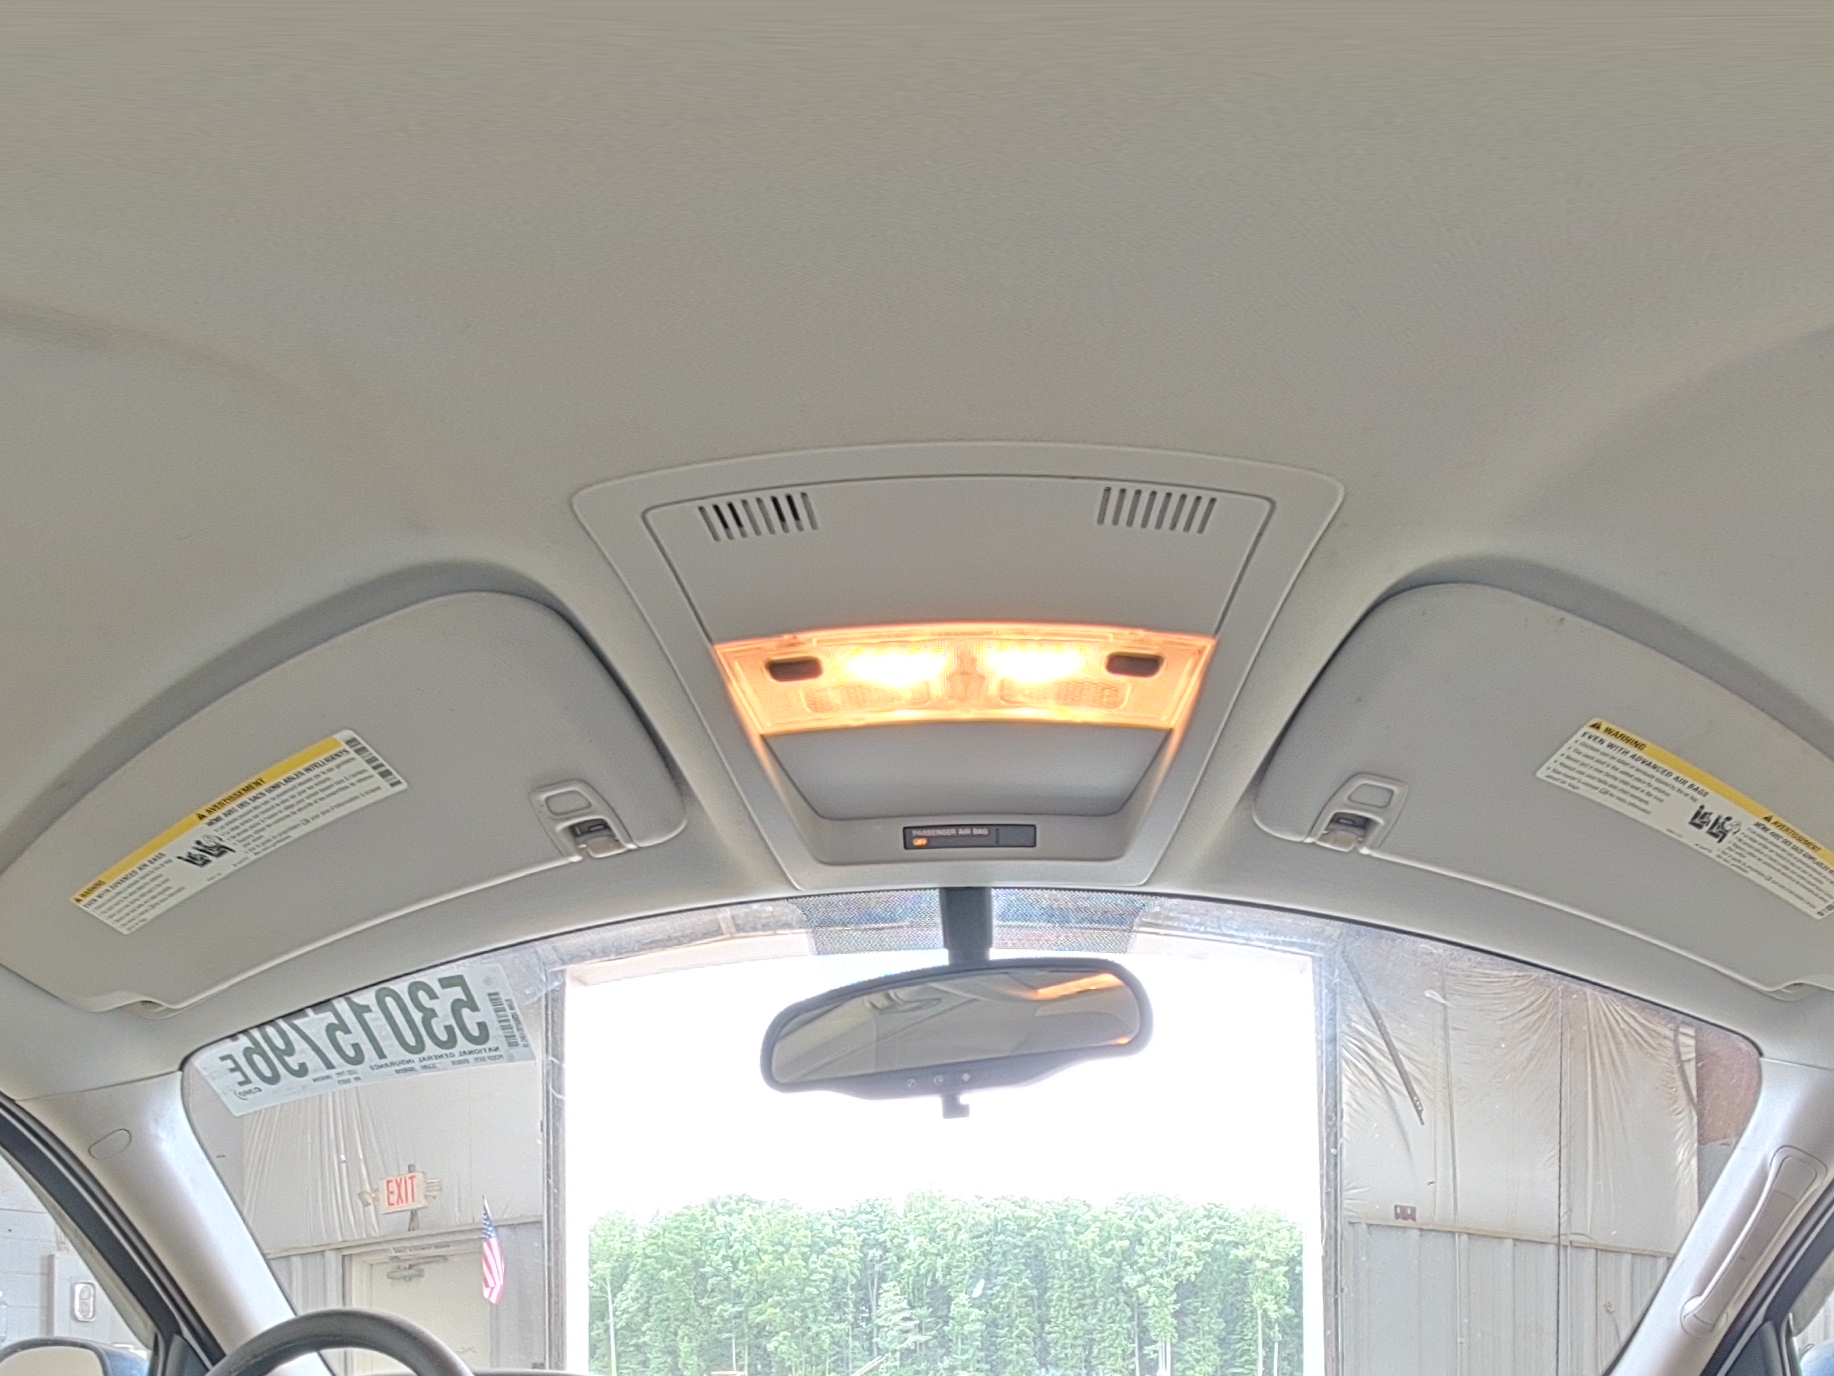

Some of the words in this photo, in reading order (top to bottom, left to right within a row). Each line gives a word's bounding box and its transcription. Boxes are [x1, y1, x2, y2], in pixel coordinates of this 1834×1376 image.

[1602, 726, 1648, 752] WARNING
[1581, 731, 1606, 746] EVEN
[1606, 741, 1631, 757] WITH
[1629, 753, 1674, 778] ADVANCED
[1673, 774, 1689, 787] AIR
[1687, 782, 1710, 798] BAGS
[972, 827, 989, 835] BAG
[386, 1175, 416, 1207] EXIT
